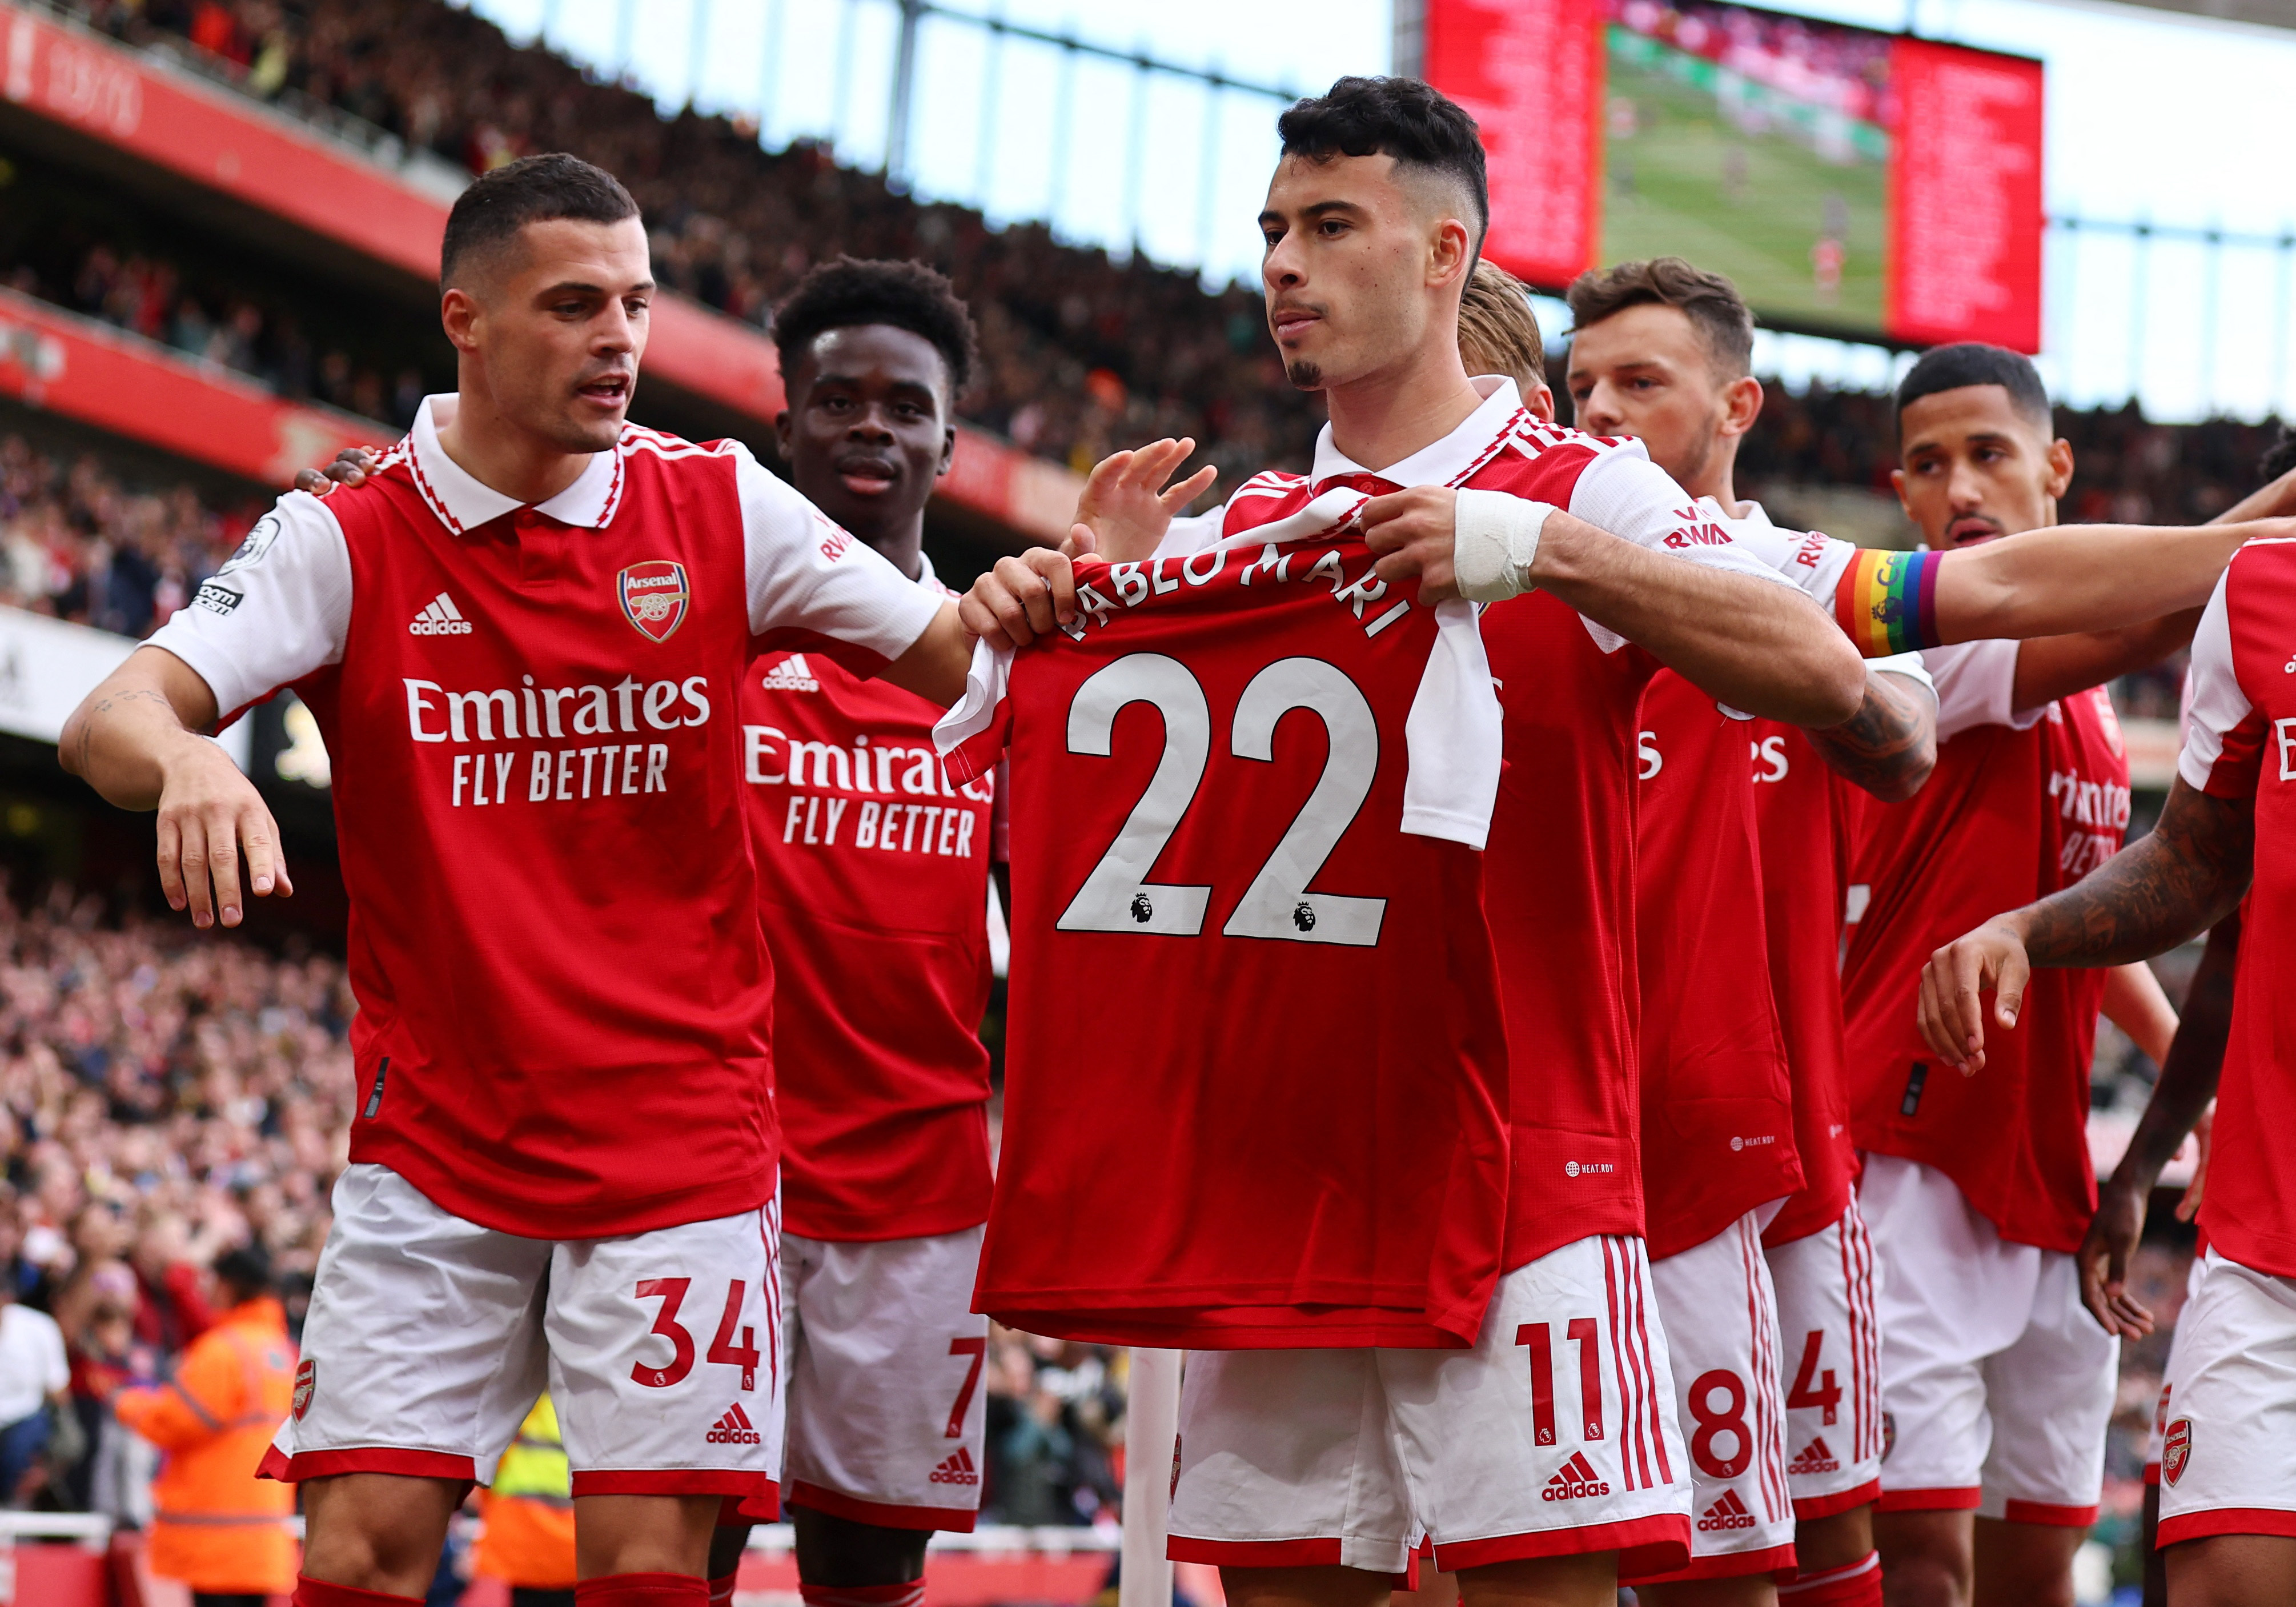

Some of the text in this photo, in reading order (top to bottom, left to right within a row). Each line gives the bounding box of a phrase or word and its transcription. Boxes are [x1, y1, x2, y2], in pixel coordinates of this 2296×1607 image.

[1663, 523, 1733, 549] RWA
[198, 586, 236, 605] oom
[626, 572, 677, 590] Arsenal
[1055, 543, 1410, 642] PABLO MARI
[409, 619, 473, 636] adidas
[762, 675, 820, 693] adidas
[402, 674, 710, 742] Emirates
[452, 743, 669, 807] FLY BETTER
[1056, 651, 1388, 947] 22
[782, 796, 975, 857] FLY BETTER
[1581, 1164, 1613, 1175] HEAT.RDY
[630, 1277, 761, 1392] 34
[944, 1337, 987, 1438] 7
[1514, 1317, 1604, 1446] 11
[1787, 1329, 1843, 1426] 4
[706, 1428, 761, 1444] adidas
[1688, 1369, 1753, 1478] 8
[1788, 1460, 1840, 1475] adidas
[1542, 1480, 1610, 1502] adidas
[1697, 1514, 1756, 1532] adidas
